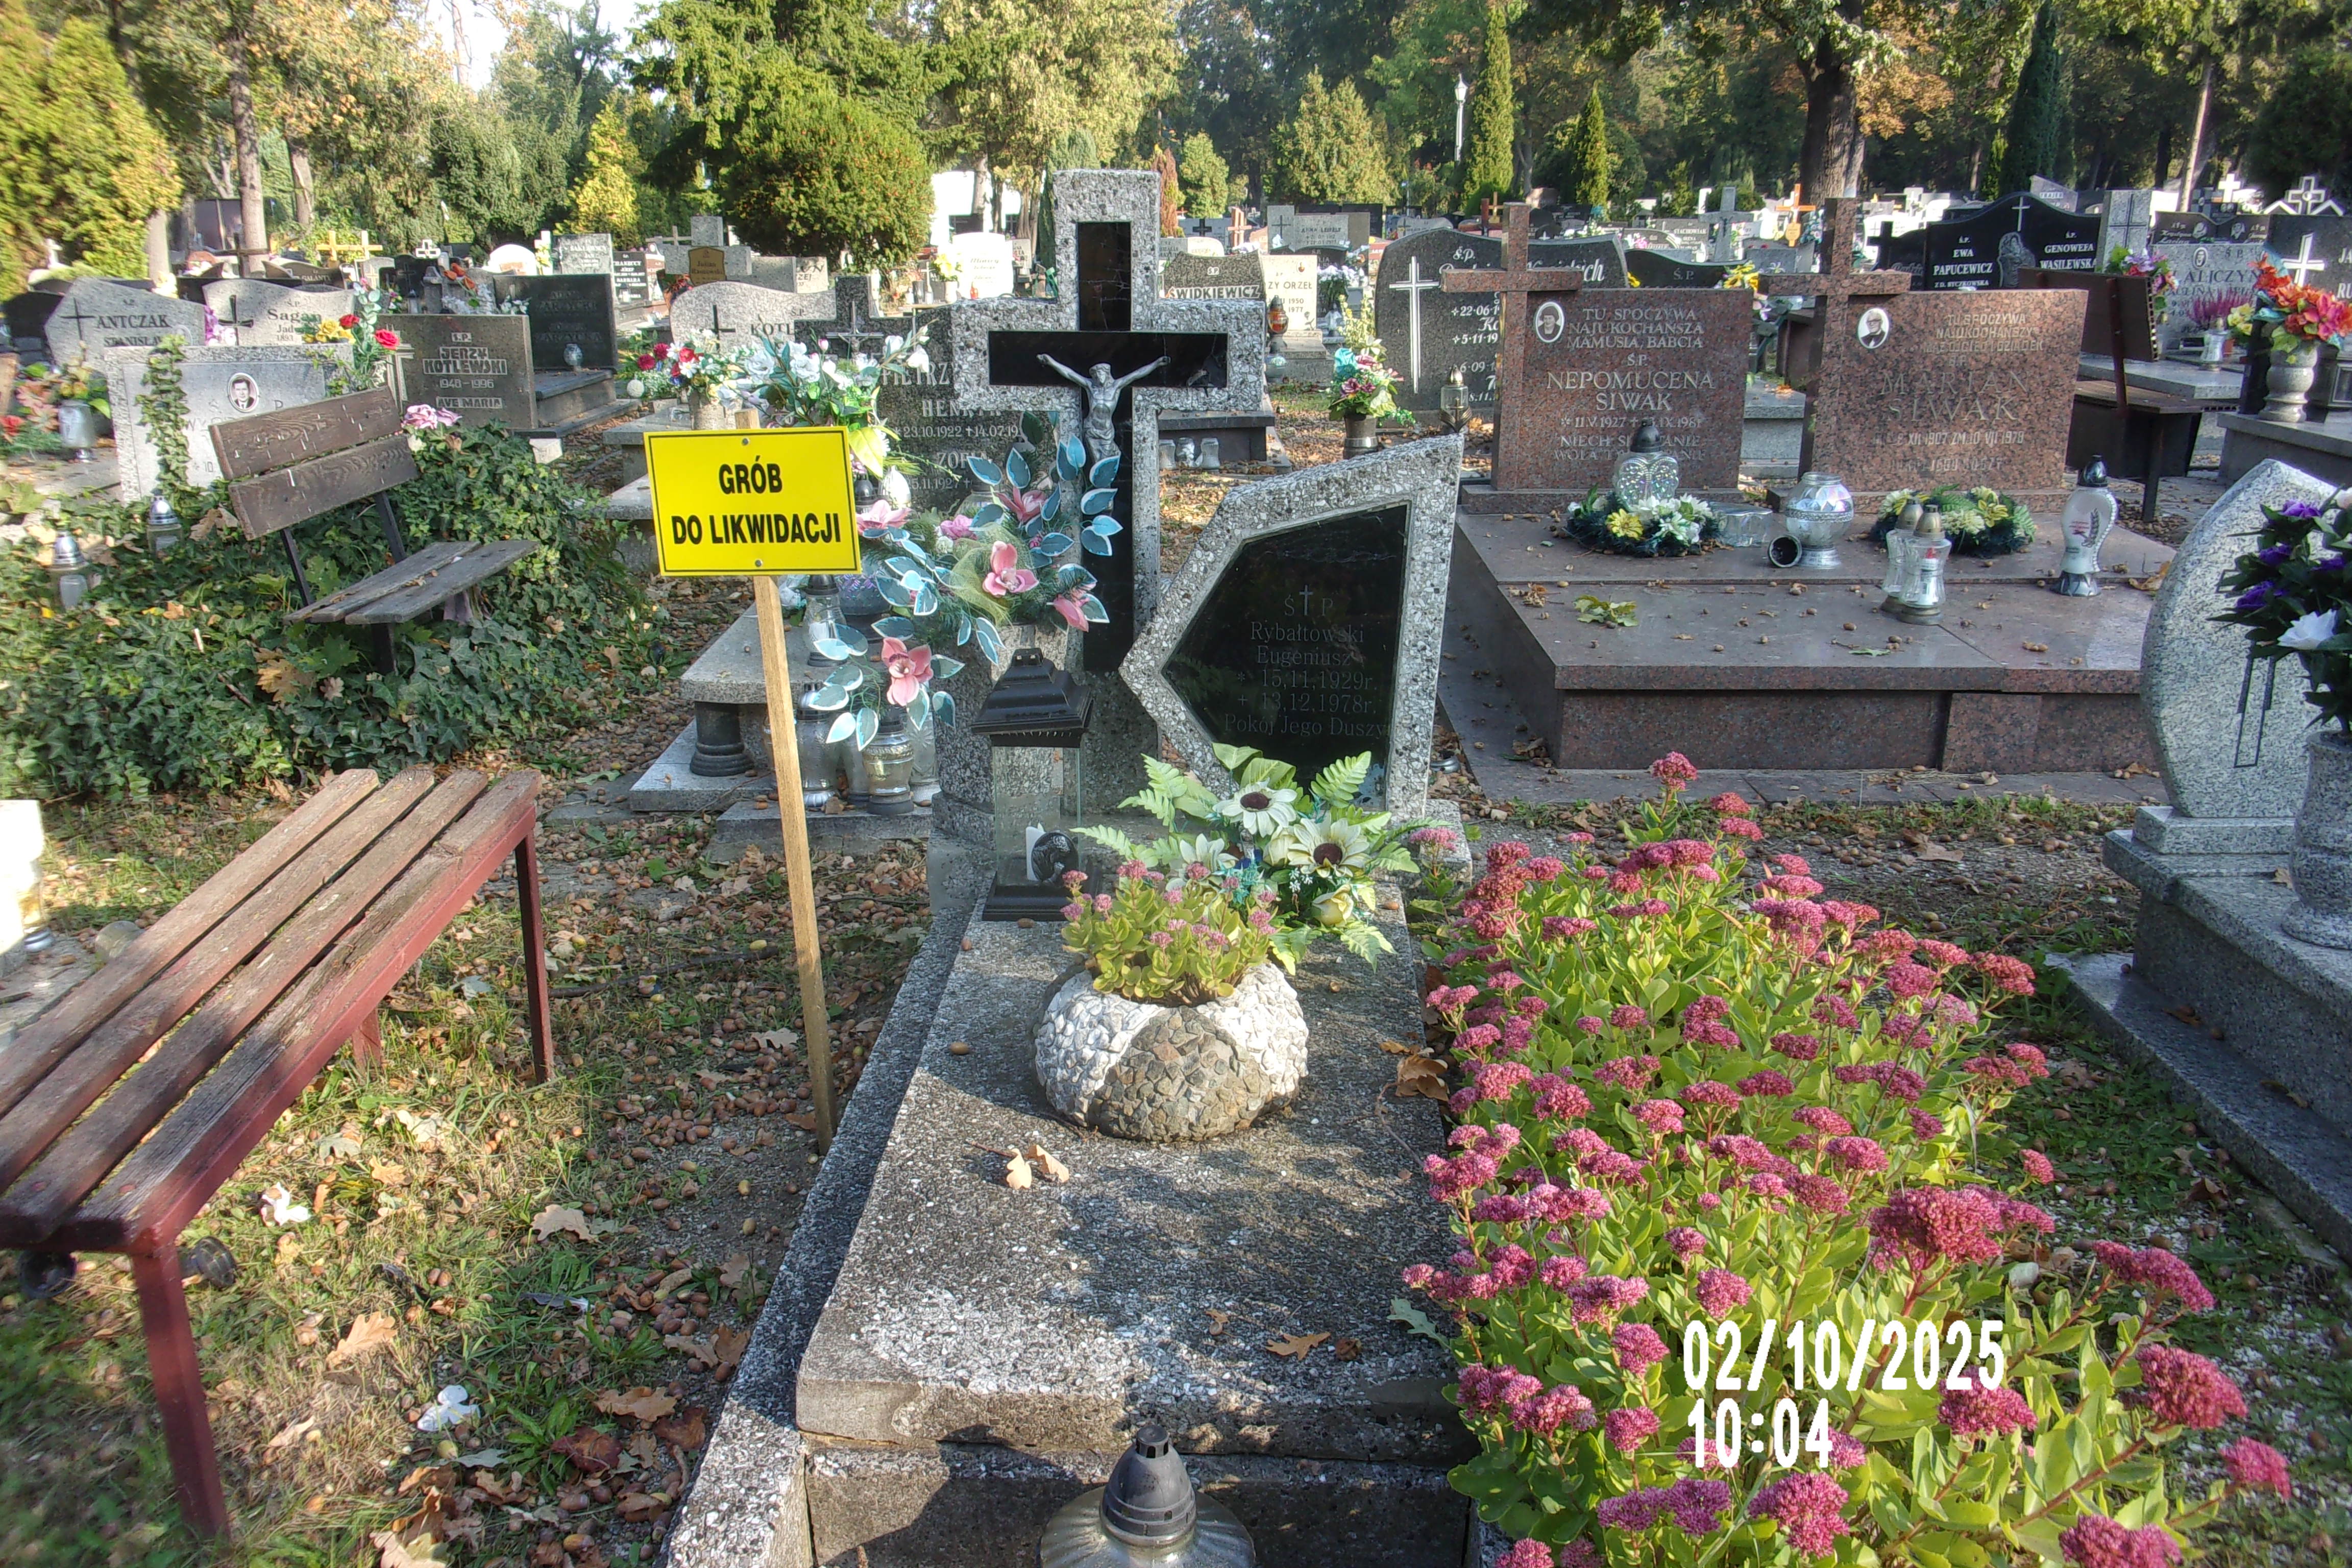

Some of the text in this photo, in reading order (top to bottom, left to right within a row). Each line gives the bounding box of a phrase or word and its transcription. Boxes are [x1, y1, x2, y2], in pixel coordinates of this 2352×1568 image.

[1953, 249, 1974, 258] EWA
[2044, 243, 2094, 254] GENOWEFA
[1933, 262, 1993, 277] PAPUCEWICZ
[1283, 281, 1312, 289] ORZEŁ
[96, 314, 173, 329] ANTCZAK
[1584, 308, 1698, 321] TU SPOCZYWA
[1947, 313, 2026, 326] TU SPOCZYWA
[1647, 337, 1704, 349] BABCIA
[440, 348, 487, 359] JERZY
[424, 359, 507, 374] KOTLEWSKI
[1546, 371, 1716, 390] NEPOMUCENA
[1879, 370, 2031, 396] MARIAN
[437, 398, 501, 408] AVE MARIA
[1596, 391, 1672, 411] SIWAK
[1888, 396, 2019, 422] SIWAK
[1560, 434, 1611, 447] NIECH
[718, 455, 783, 495] GRÓB
[671, 512, 841, 545] DO LIKWIDACJI
[1251, 621, 1364, 644] Rybałtowski
[1257, 645, 1353, 667] Eugeniusz
[1225, 714, 1386, 740] Pokój Jego Duszy
